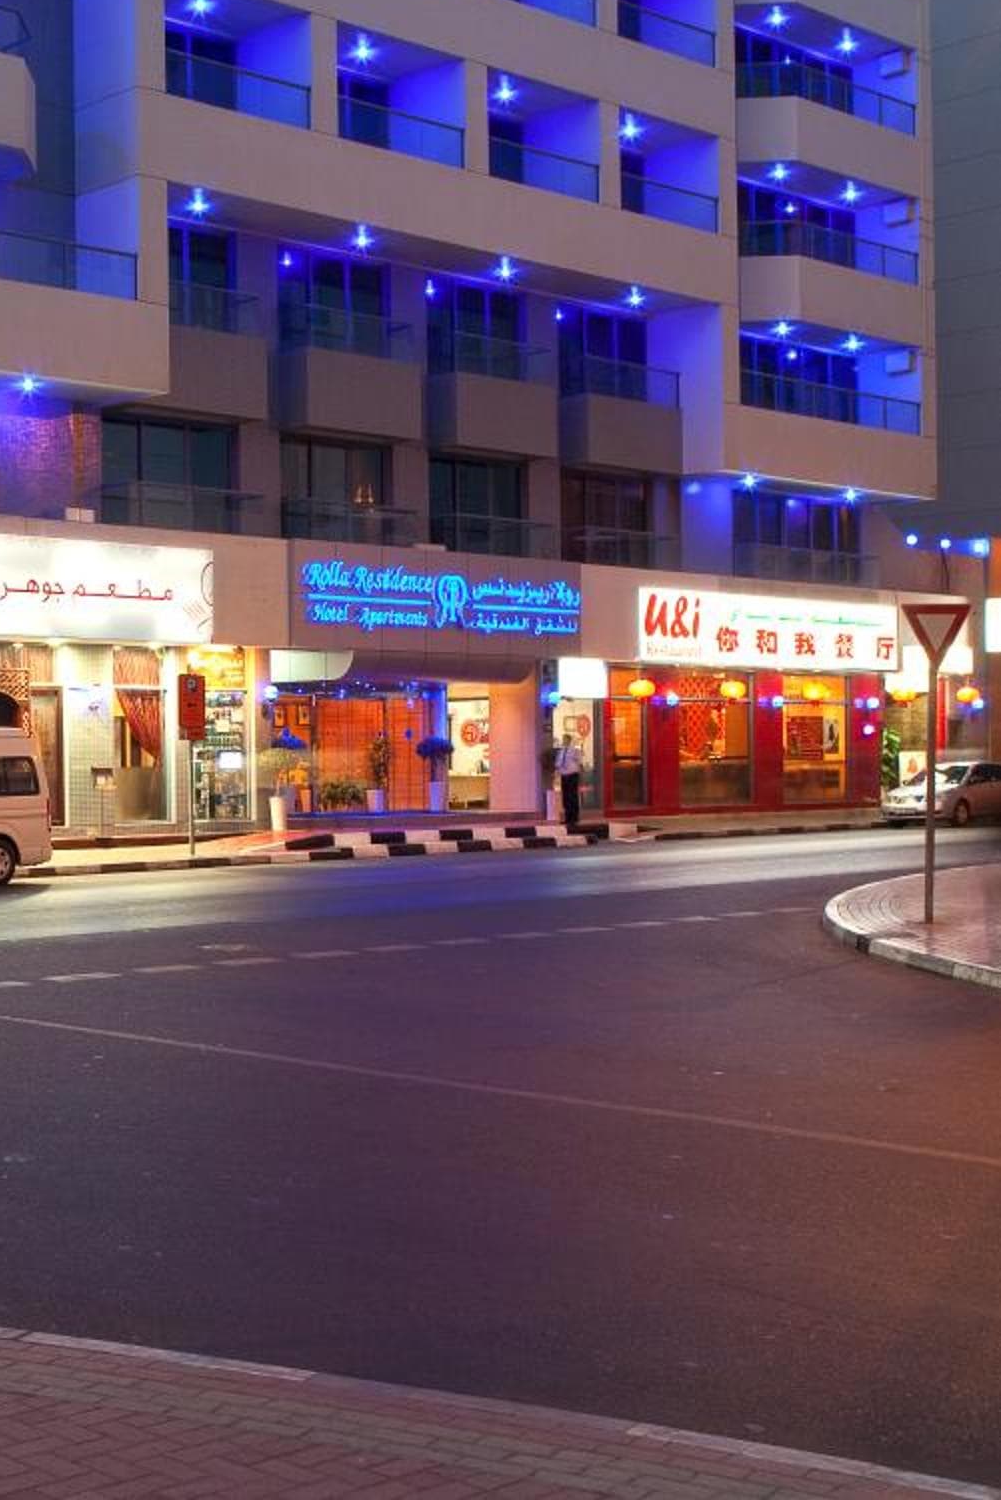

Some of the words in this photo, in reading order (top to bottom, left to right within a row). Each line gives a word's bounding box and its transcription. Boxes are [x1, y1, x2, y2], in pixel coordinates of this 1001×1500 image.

[72, 579, 173, 601] مطعم
[303, 561, 350, 591] Rolla
[350, 564, 433, 595] Residence
[310, 601, 349, 622] Hotel
[356, 607, 428, 632] Apartments
